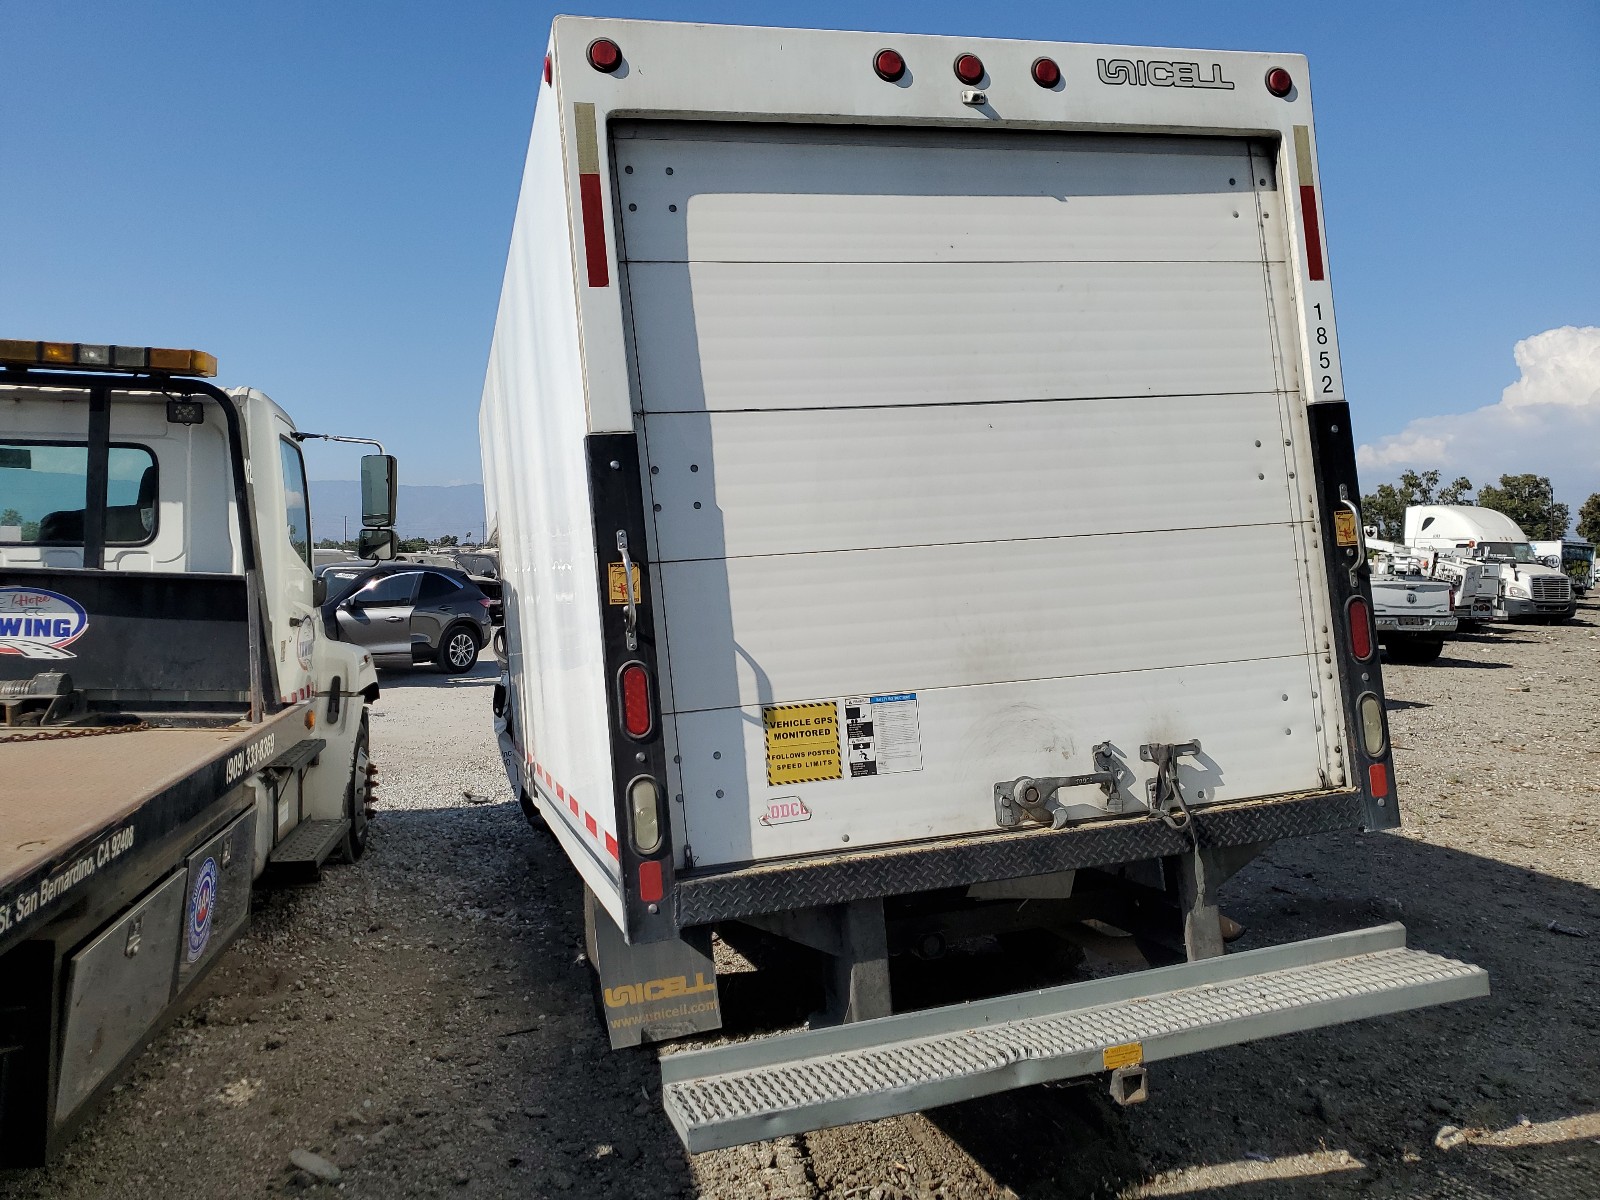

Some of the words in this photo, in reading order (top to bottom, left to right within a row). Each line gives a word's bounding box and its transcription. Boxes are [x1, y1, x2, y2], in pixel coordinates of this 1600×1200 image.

[1097, 58, 1235, 90] UNICELL
[1313, 302, 1334, 394] 1852
[769, 718, 811, 730] VEHICLE
[813, 716, 833, 725] GPS
[773, 728, 831, 741] MONITORED
[225, 750, 245, 785] (909)
[771, 751, 806, 761] FOLLOWS
[807, 749, 836, 758] POSTED
[776, 762, 803, 771] SPEED
[805, 759, 833, 768] LIMITS
[15, 891, 38, 922] San
[40, 856, 95, 907] Bernardino,
[96, 840, 111, 868] CA
[111, 824, 135, 859] 92408
[604, 972, 716, 1008] UNICELL
[610, 1000, 718, 1029] www.unicell.com
